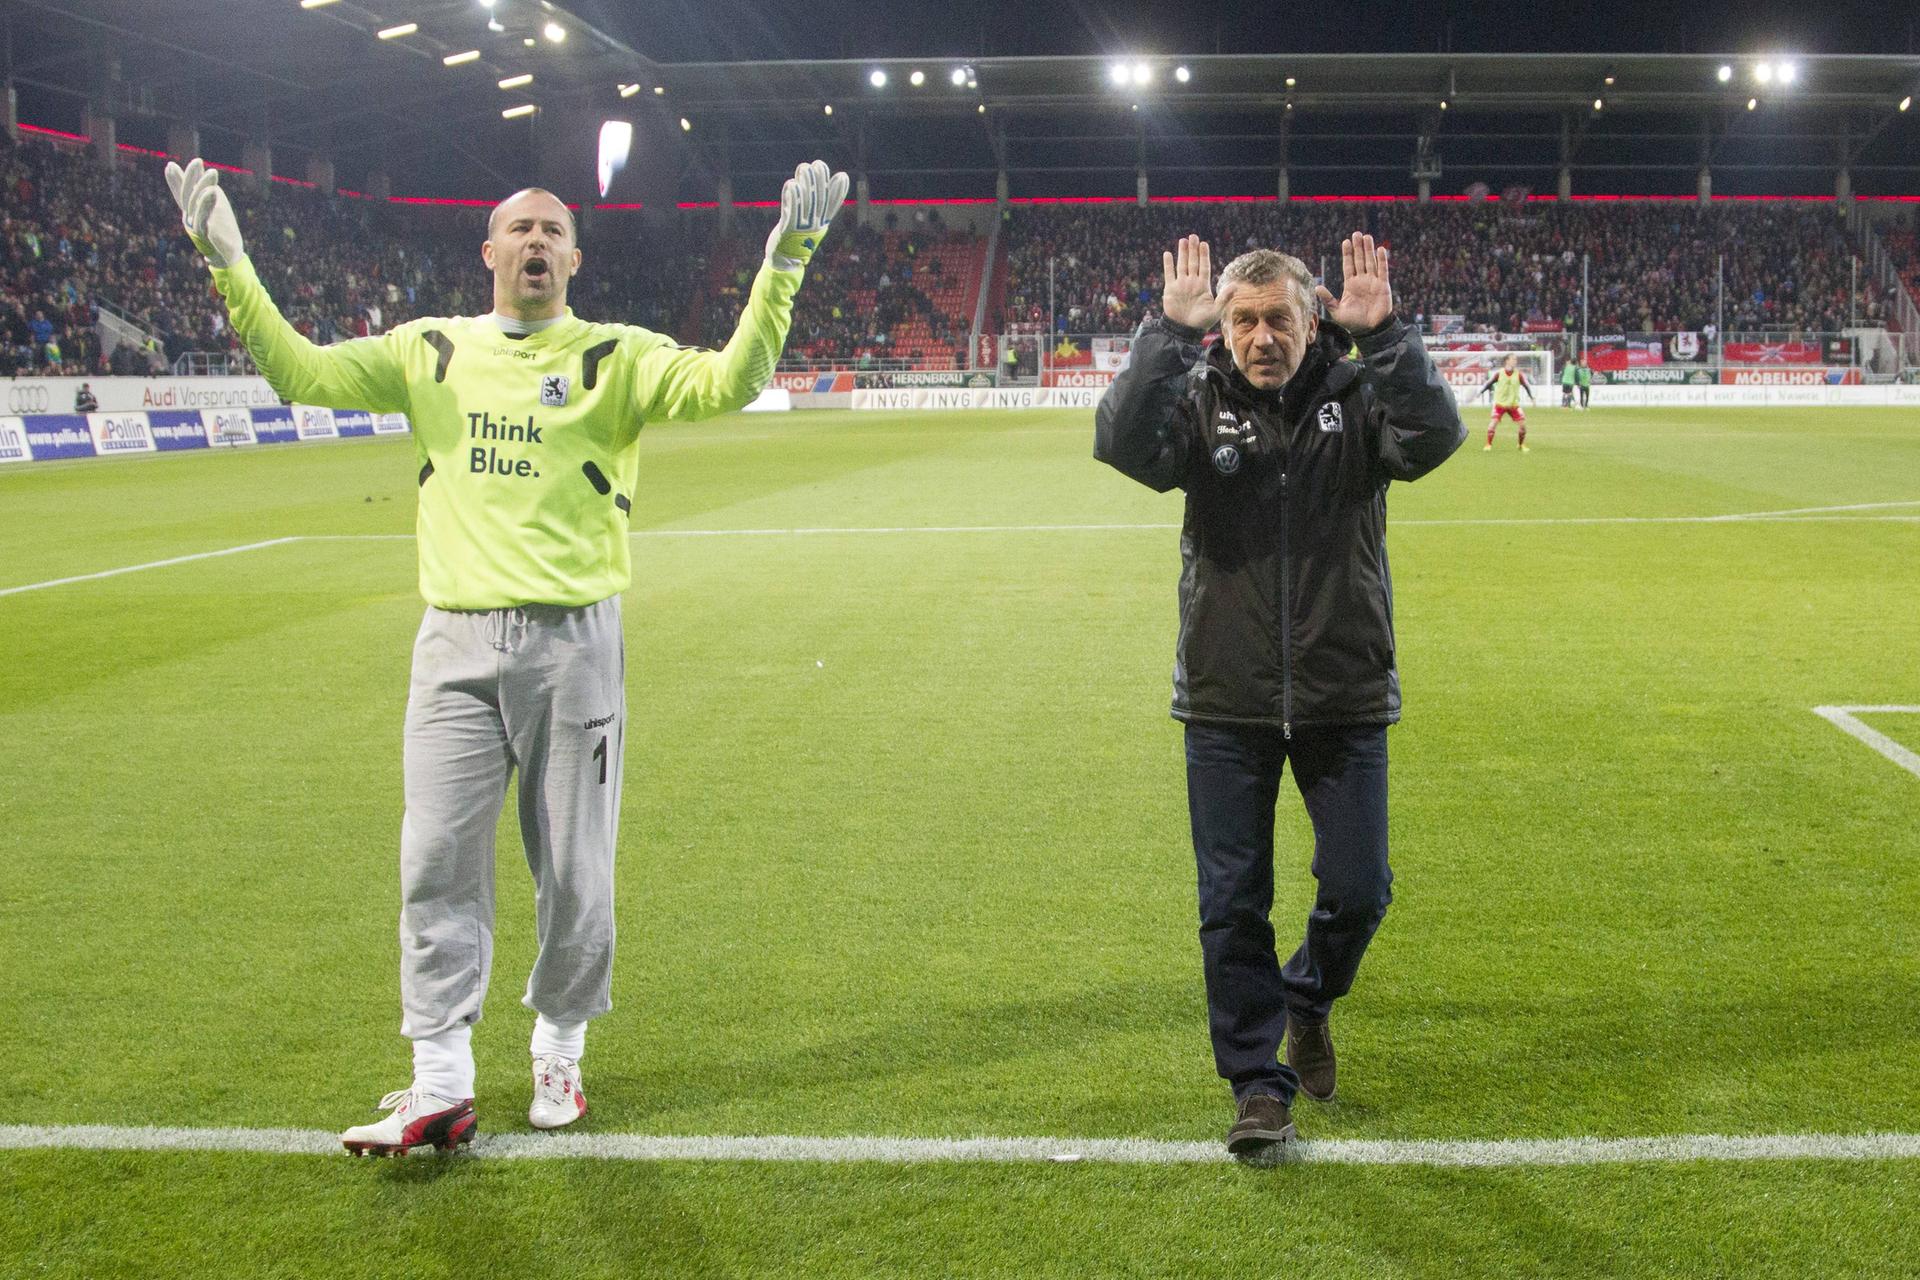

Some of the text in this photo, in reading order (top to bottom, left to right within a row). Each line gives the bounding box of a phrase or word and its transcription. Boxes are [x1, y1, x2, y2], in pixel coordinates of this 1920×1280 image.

[144, 386, 177, 407] Audi
[180, 385, 248, 408] Vorsprung
[871, 393, 910, 408] INVG
[932, 392, 970, 408] INVG
[992, 391, 1031, 407] INVG
[1052, 391, 1091, 407] INVG
[105, 417, 146, 439] Pollin
[215, 413, 251, 435] Pollin
[304, 410, 330, 428] Pollin
[467, 412, 544, 444] Think
[469, 447, 541, 478] Blue.
[583, 712, 615, 730] uhlsport
[592, 735, 607, 785] 1
